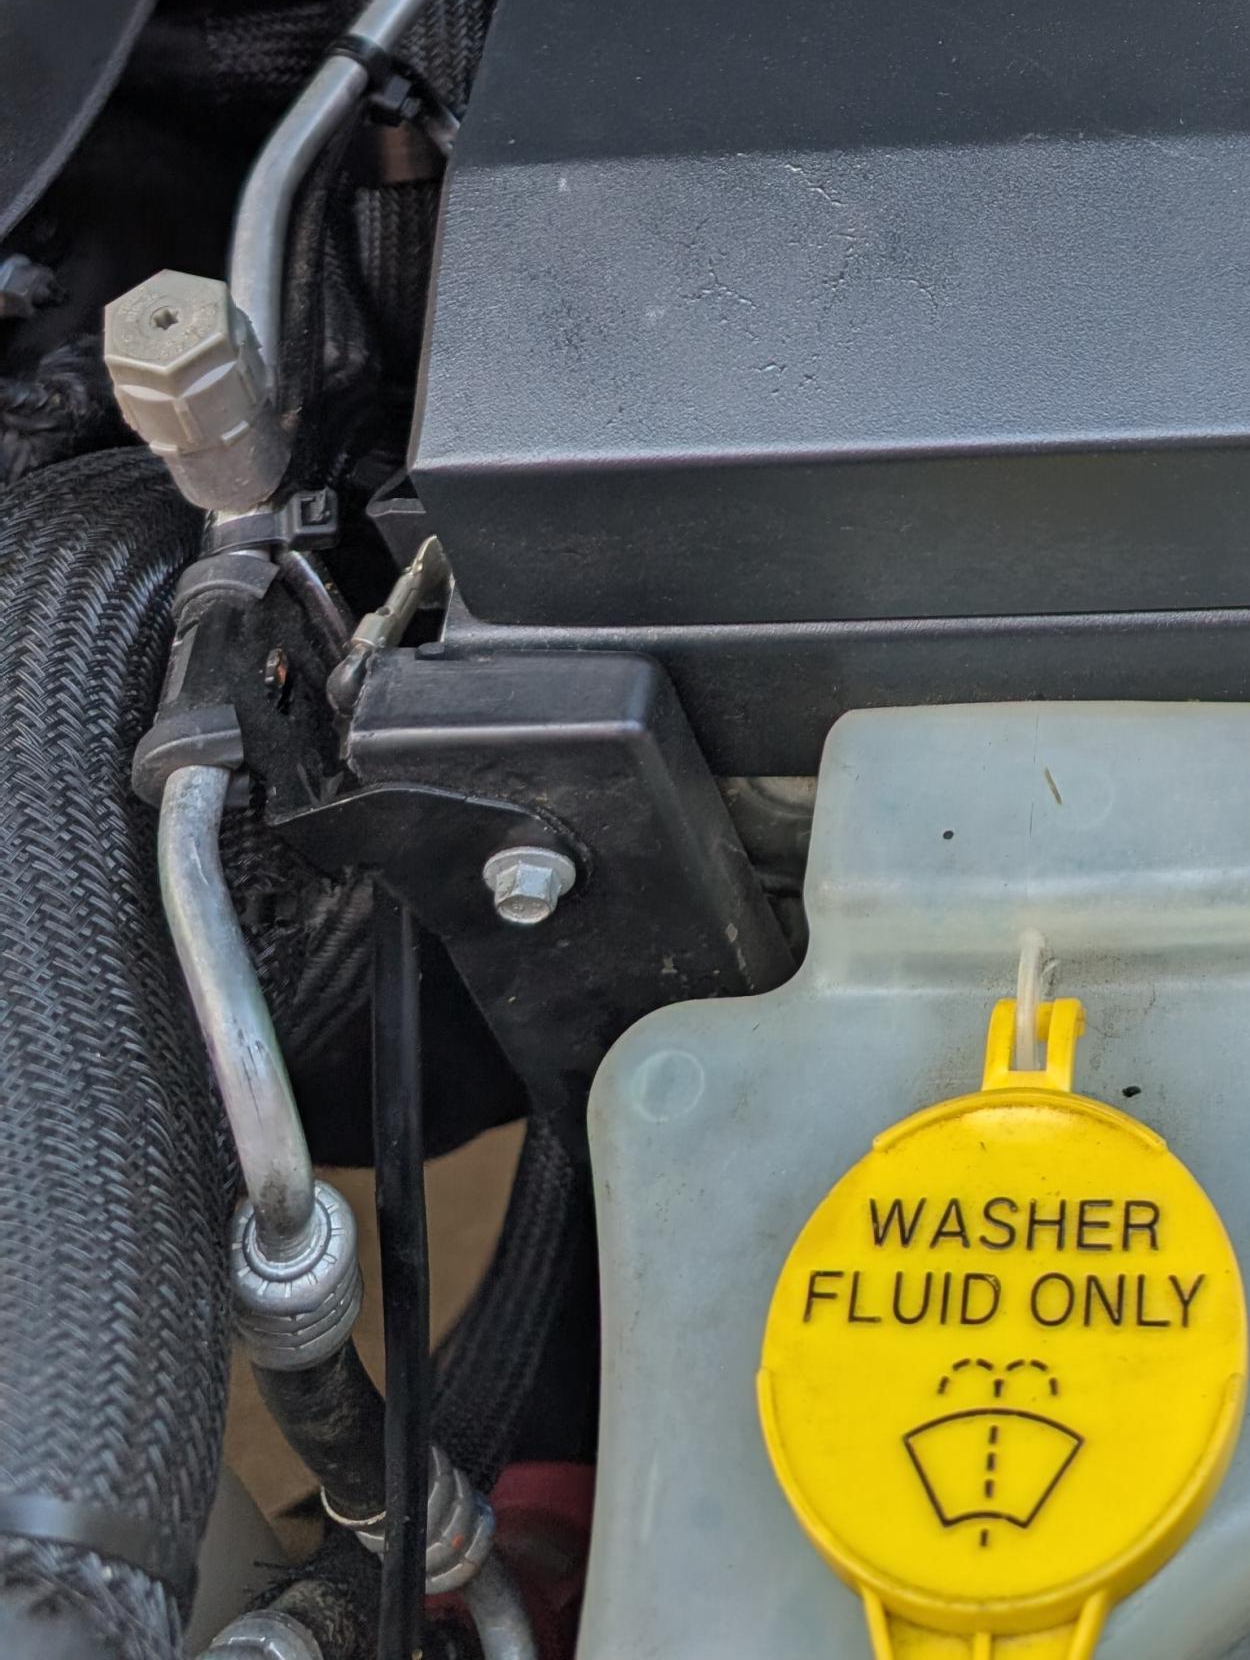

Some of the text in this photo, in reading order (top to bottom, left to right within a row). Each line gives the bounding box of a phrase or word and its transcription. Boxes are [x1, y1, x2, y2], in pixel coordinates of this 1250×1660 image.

[869, 1197, 1161, 1251] WASHER
[801, 1269, 1206, 1328] FLUID ONLY
